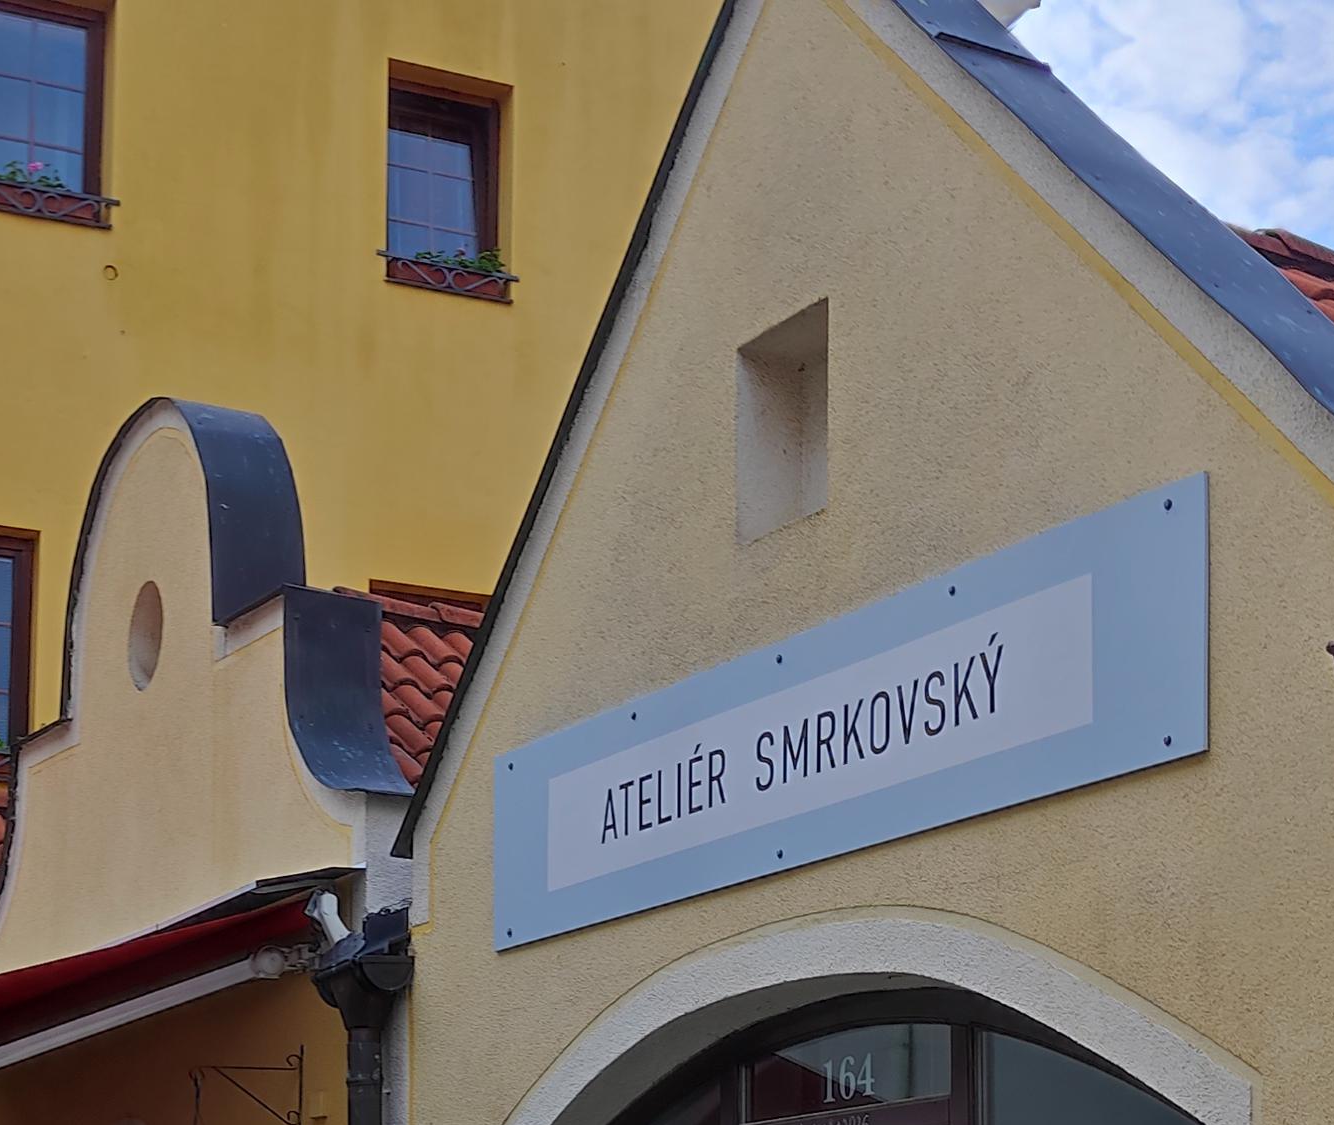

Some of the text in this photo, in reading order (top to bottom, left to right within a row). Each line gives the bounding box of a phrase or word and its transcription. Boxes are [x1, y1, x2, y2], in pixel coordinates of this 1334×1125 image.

[600, 631, 1005, 844] ATELIÉR SMRKOVSKÝ
[823, 1053, 875, 1103] 164
